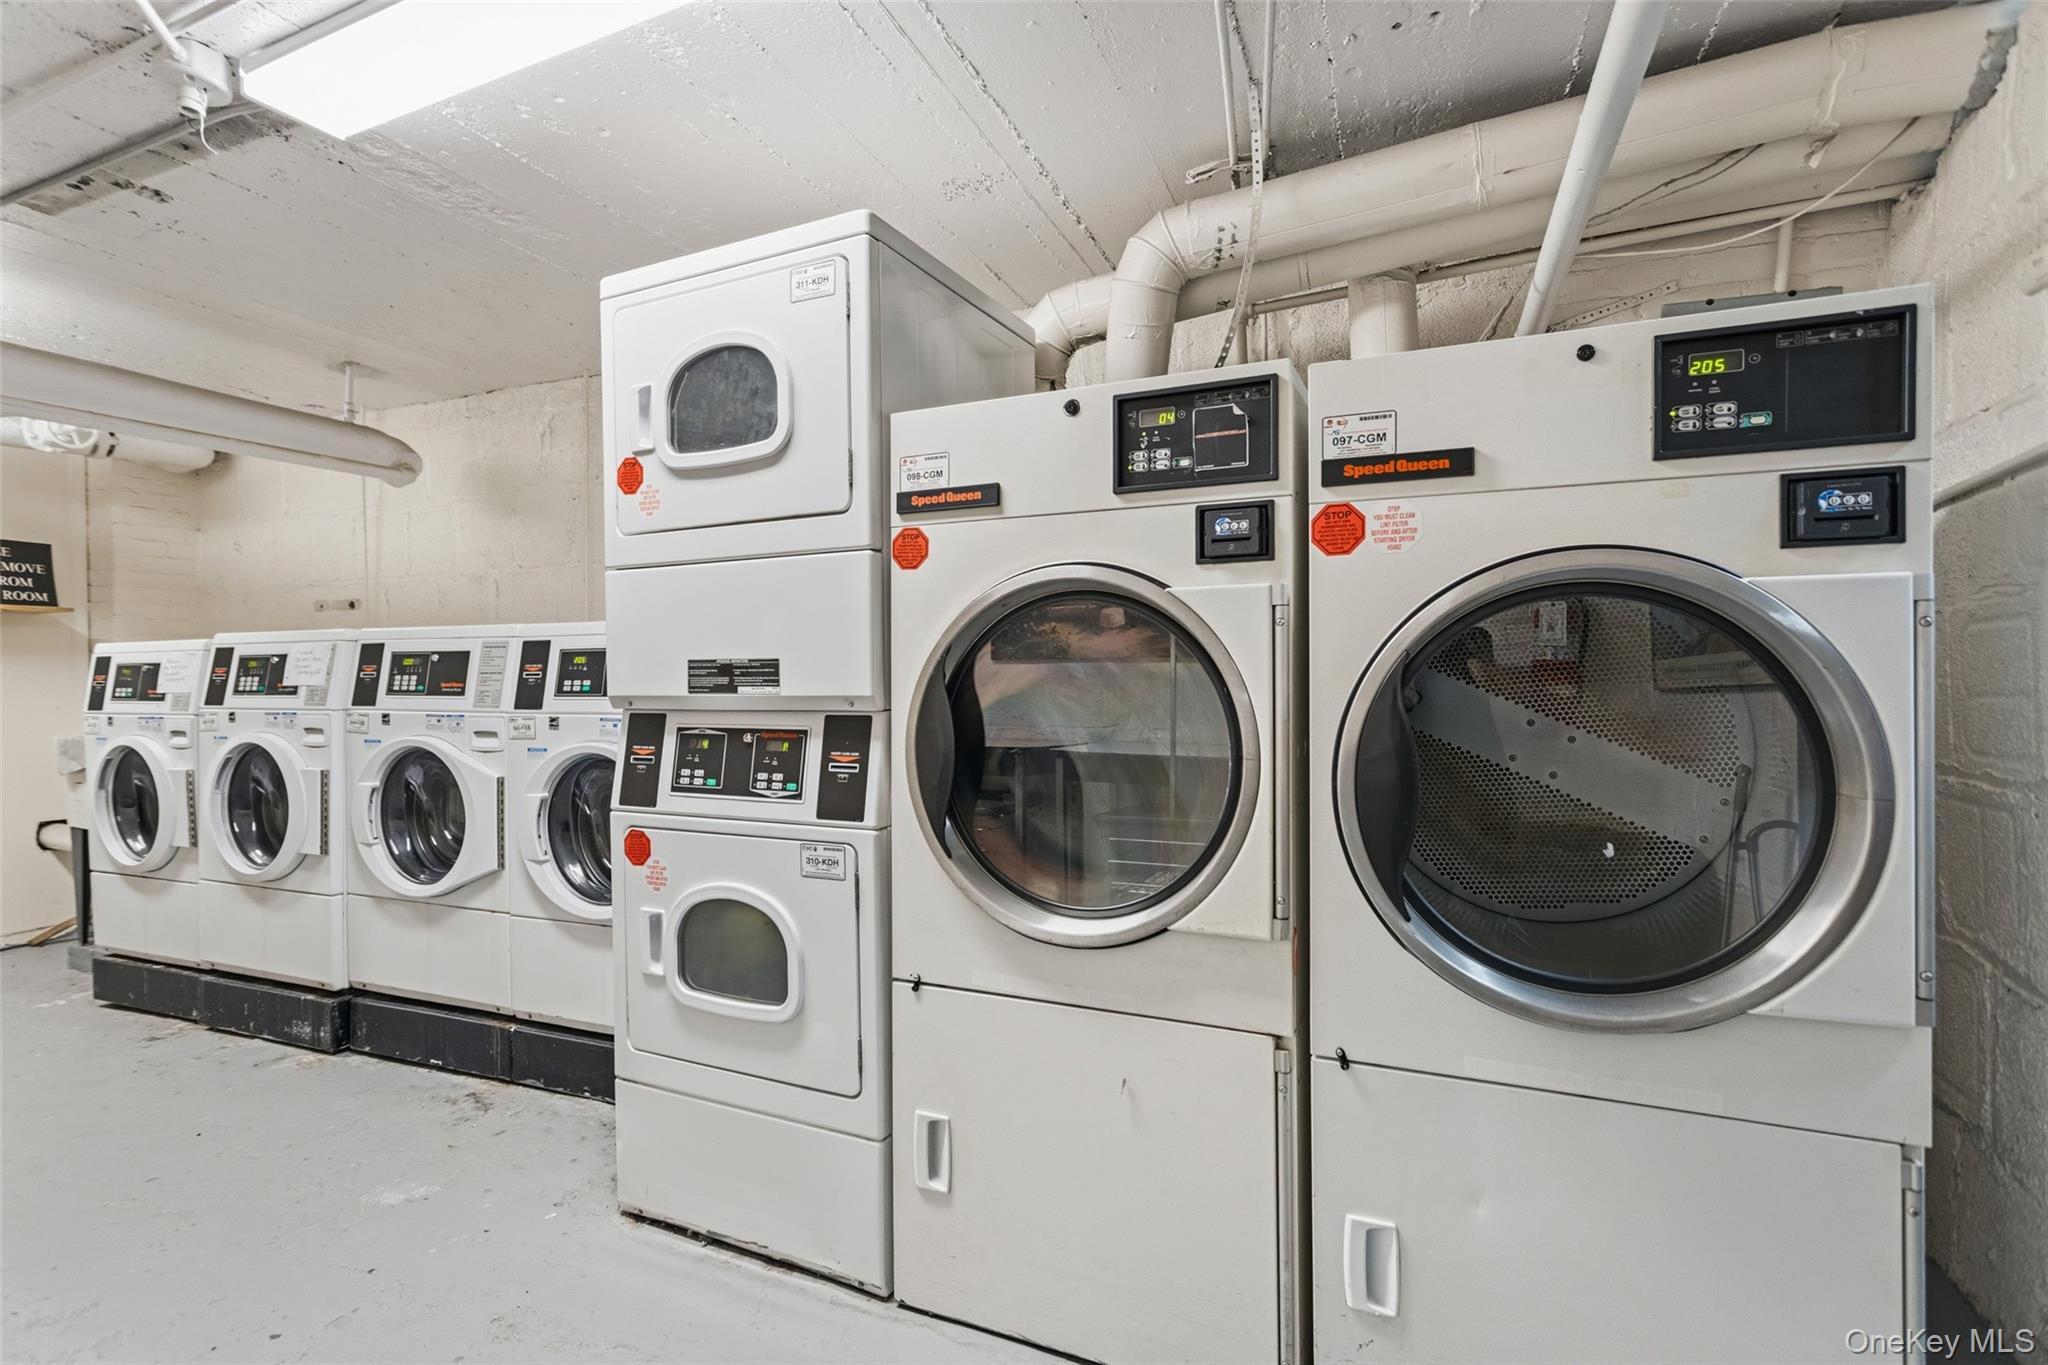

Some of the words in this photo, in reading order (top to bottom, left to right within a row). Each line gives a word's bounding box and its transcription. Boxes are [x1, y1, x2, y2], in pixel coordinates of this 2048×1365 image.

[796, 275, 829, 289] 311-KDH
[1689, 358, 1725, 376] 205
[1158, 411, 1176, 425] 04
[1332, 432, 1387, 446] 097-CGM
[906, 470, 943, 481] 098-CGM
[1343, 461, 1394, 479] Speed
[1396, 458, 1450, 472] Queen
[911, 493, 945, 507] Speed
[946, 491, 982, 502] Queen
[1324, 510, 1352, 520] STOP
[3, 590, 49, 602] ROOM
[805, 856, 839, 867] 310-KDH
